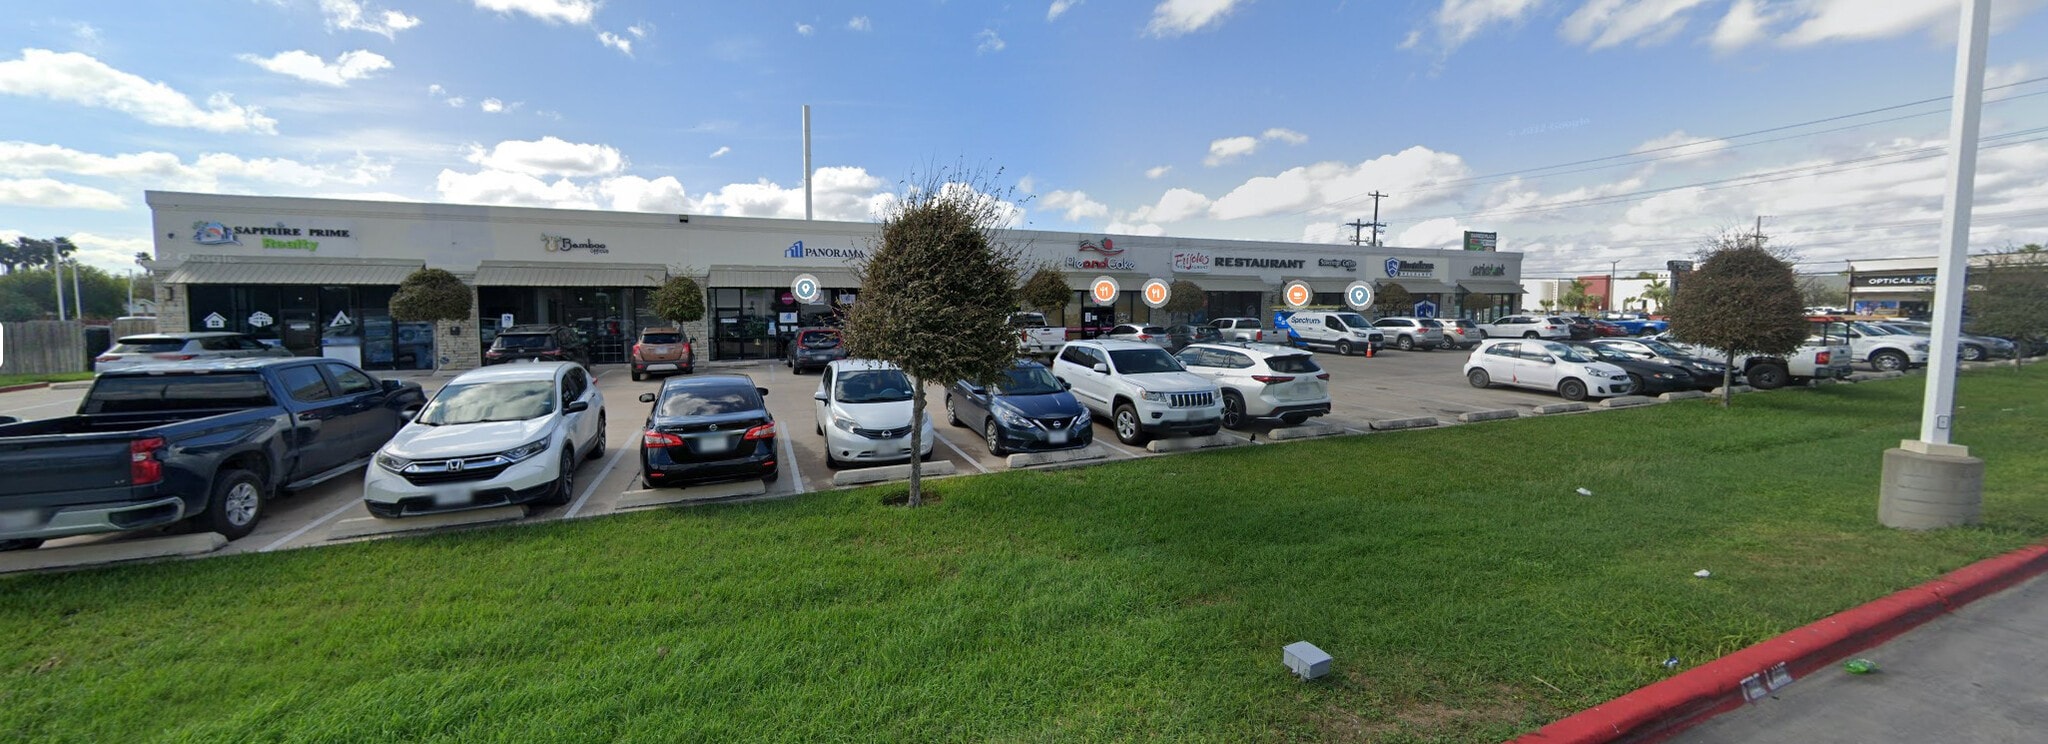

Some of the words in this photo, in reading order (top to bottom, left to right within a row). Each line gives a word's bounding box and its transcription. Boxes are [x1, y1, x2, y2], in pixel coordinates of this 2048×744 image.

[233, 226, 301, 237] SAPPHIRE
[309, 228, 350, 238] PRIME
[262, 237, 320, 252] Realty
[560, 238, 606, 252] Bamboo
[805, 248, 864, 259] PANORAMA
[1214, 257, 1306, 269] RESTAURANT
[1868, 277, 1913, 285] OPTICAL
[1290, 316, 1321, 325] Spectrum
